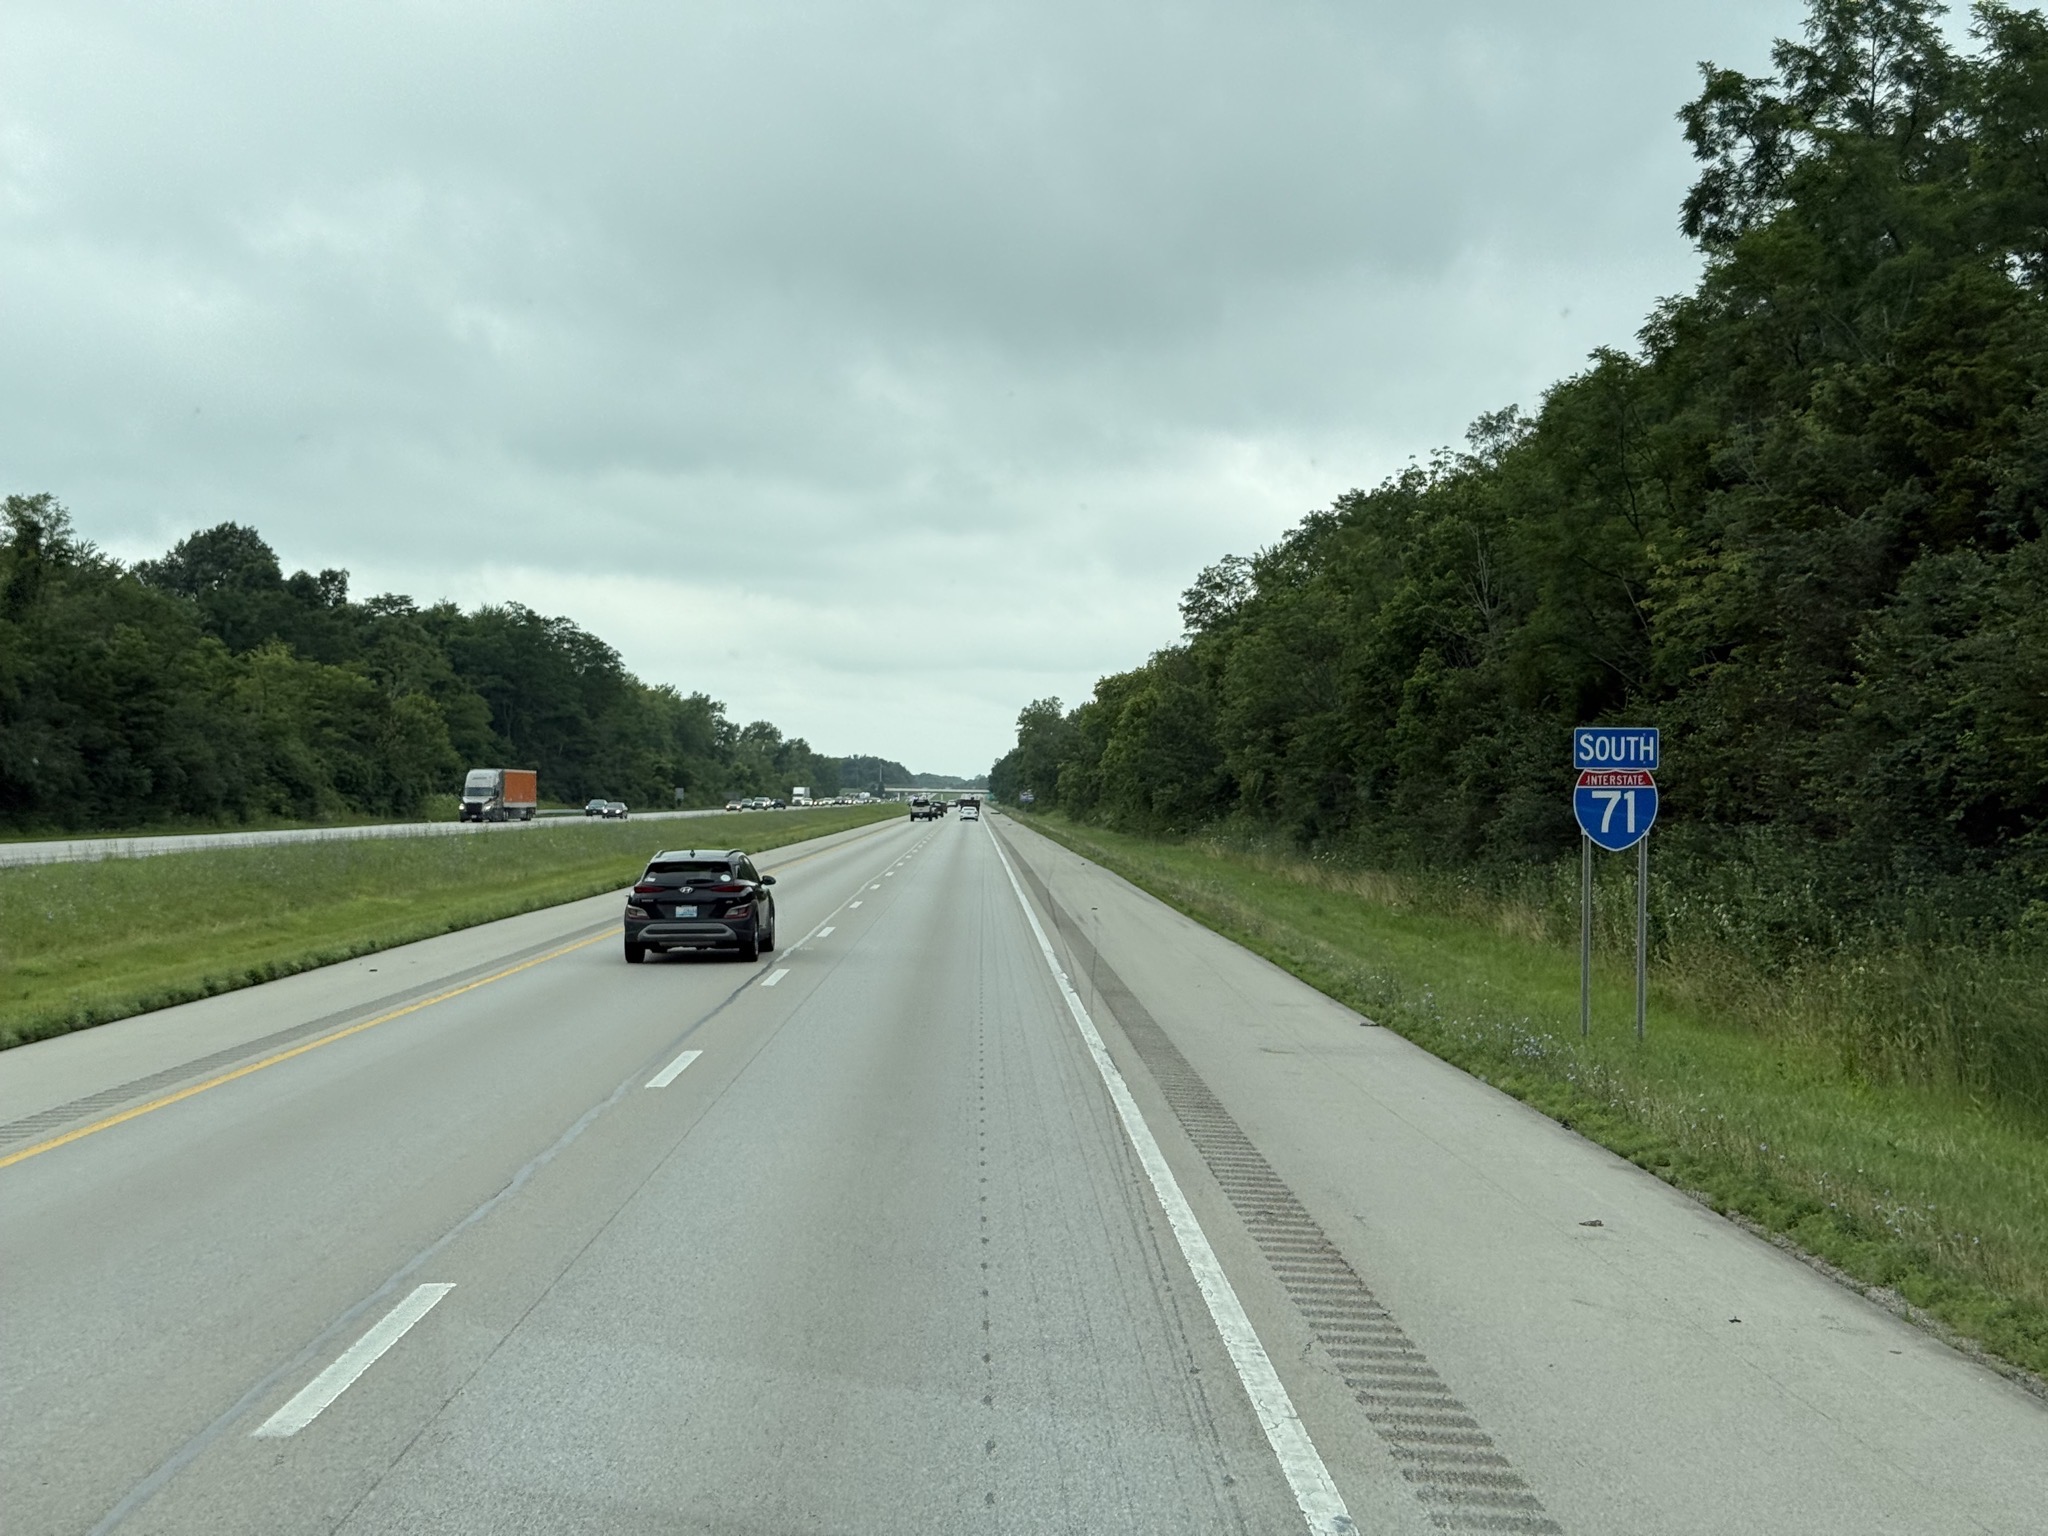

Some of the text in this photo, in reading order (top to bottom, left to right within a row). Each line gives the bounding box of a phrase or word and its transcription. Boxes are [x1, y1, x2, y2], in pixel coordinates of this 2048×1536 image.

[1579, 733, 1654, 761] SOUTH
[1586, 775, 1645, 786] INTERSTATE
[1591, 790, 1635, 833] 71
